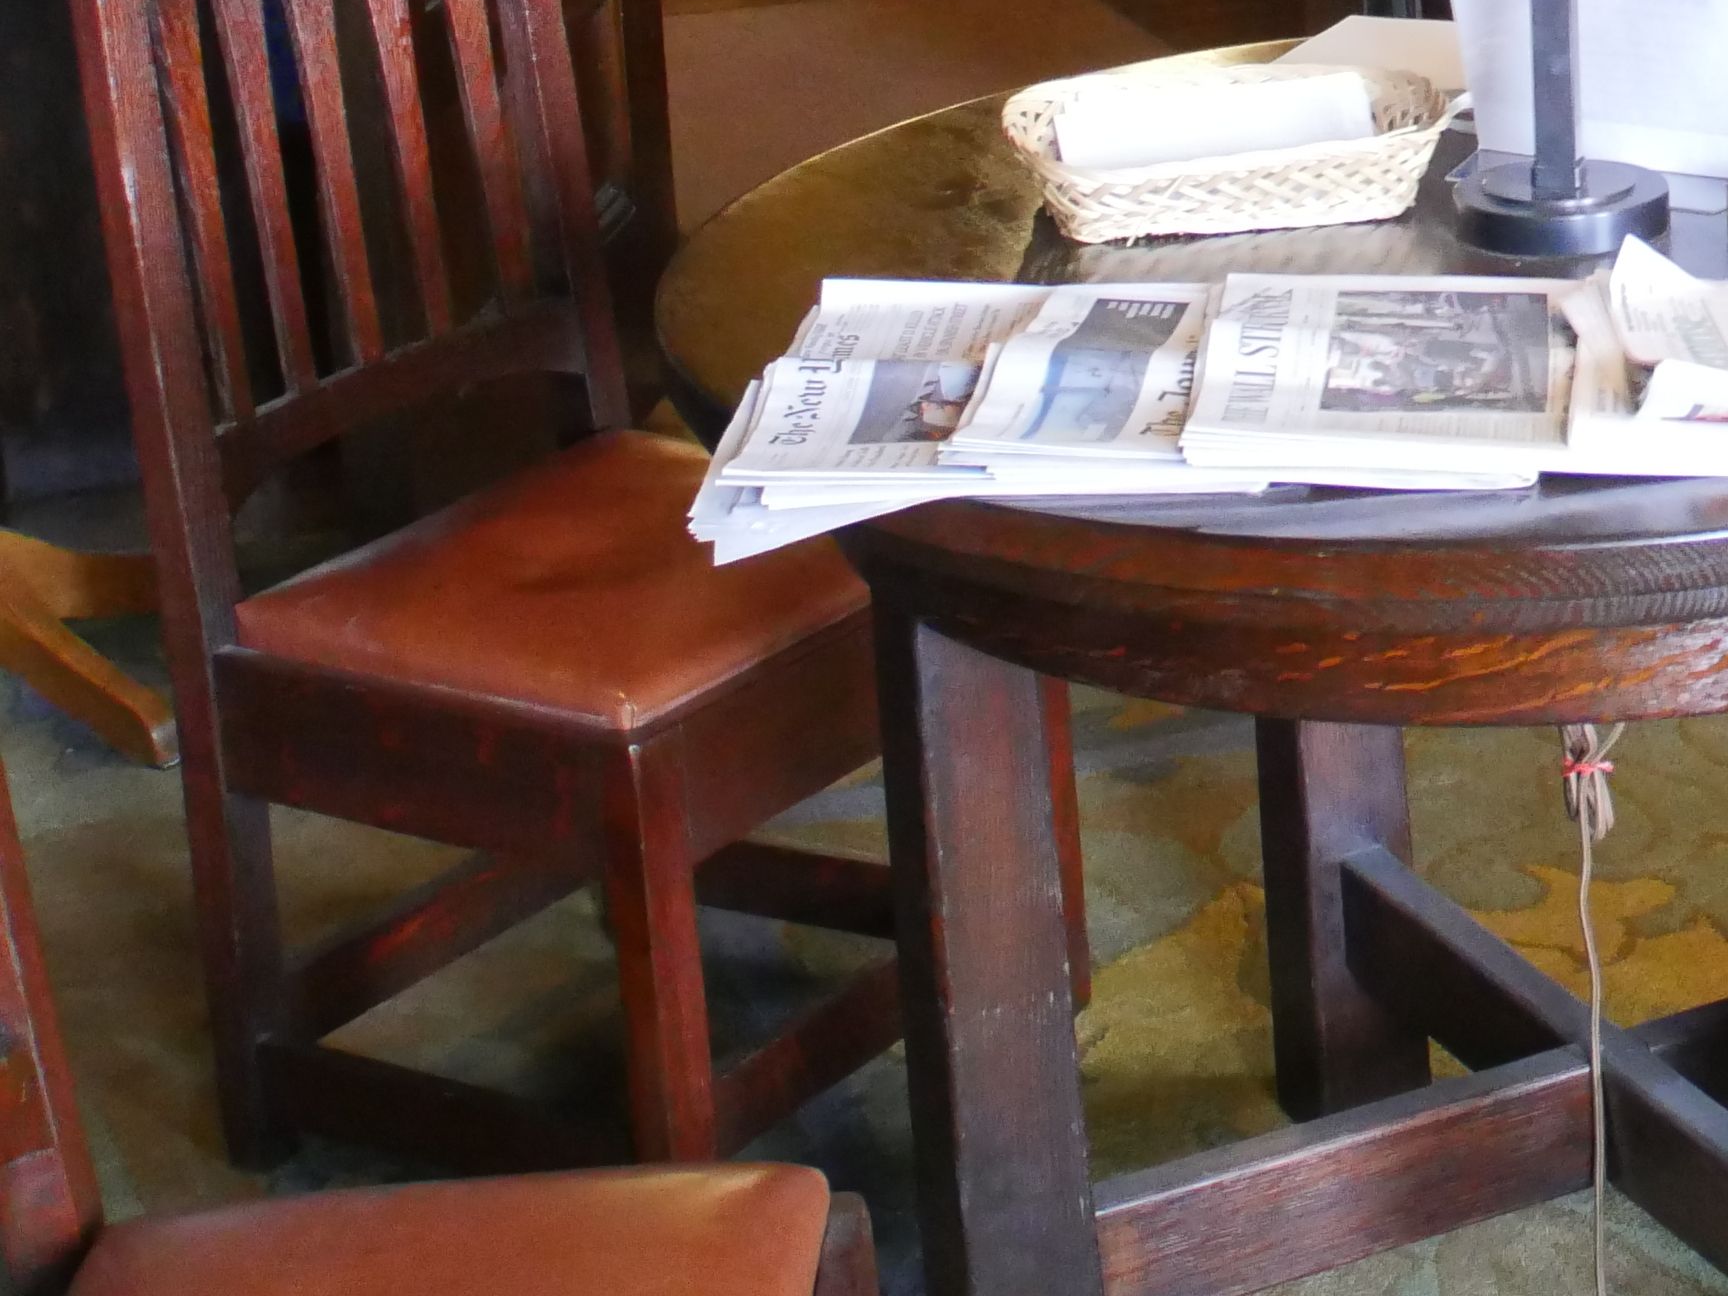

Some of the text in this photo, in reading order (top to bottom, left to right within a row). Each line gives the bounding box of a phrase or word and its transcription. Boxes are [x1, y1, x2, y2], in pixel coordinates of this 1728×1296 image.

[832, 334, 859, 359] mes
[783, 379, 826, 419] New
[1227, 365, 1277, 403] WALL
[768, 422, 816, 445] The
